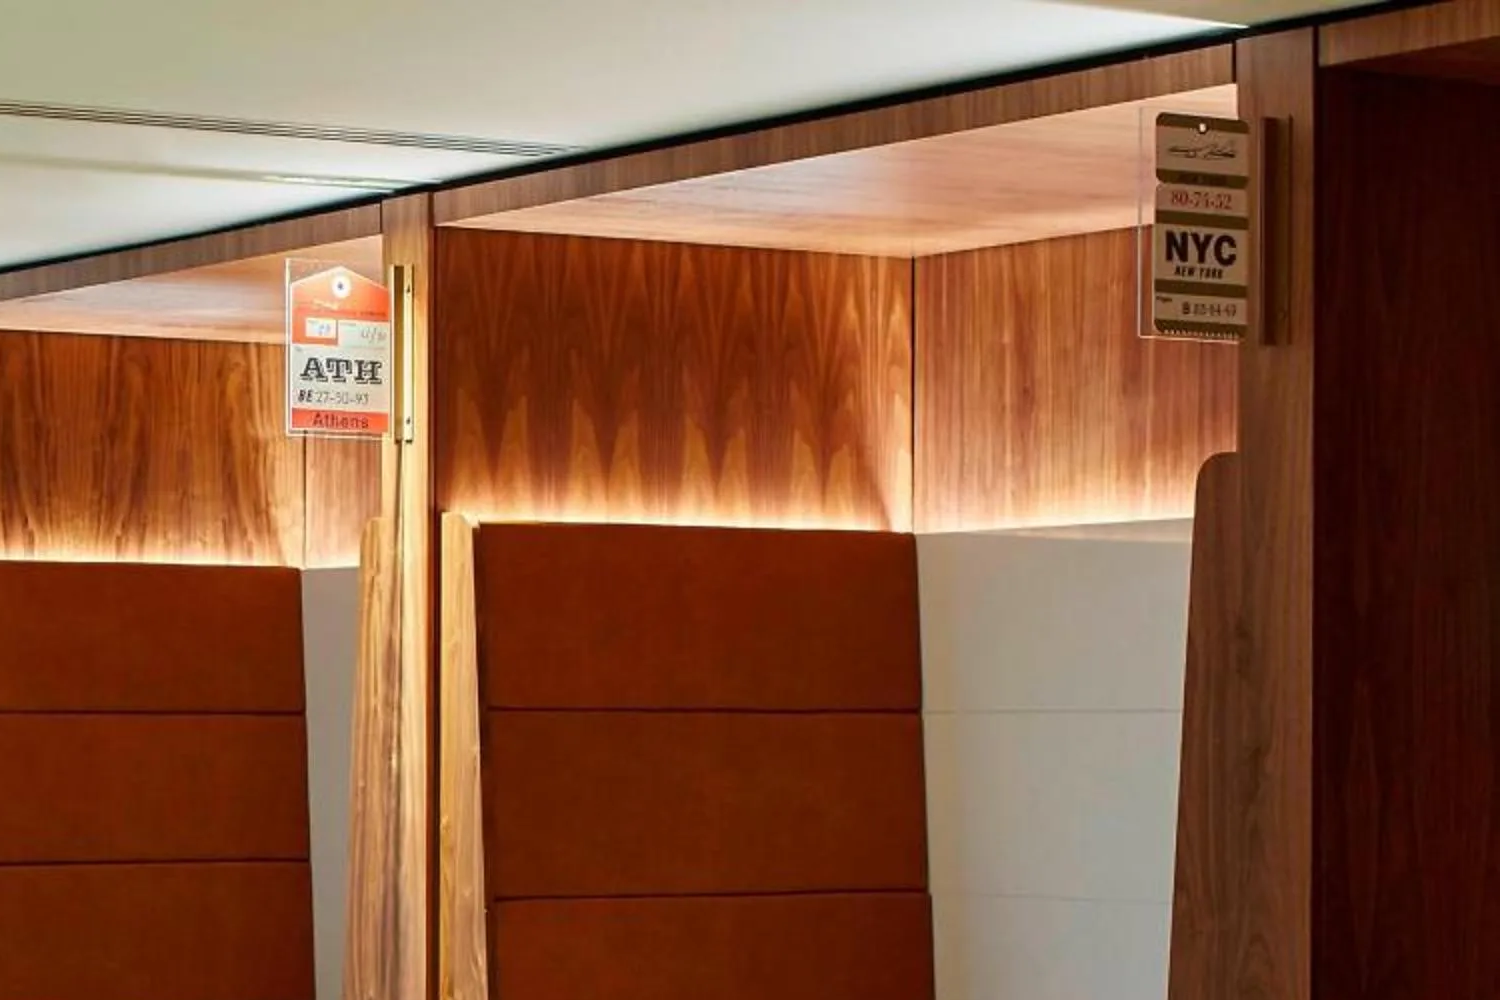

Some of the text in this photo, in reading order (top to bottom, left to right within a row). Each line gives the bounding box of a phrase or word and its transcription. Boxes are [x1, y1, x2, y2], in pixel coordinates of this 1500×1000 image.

[1165, 229, 1237, 267] NYC
[1174, 265, 1196, 277] NEW
[300, 356, 383, 385] ATH
[311, 411, 370, 430] Athens
